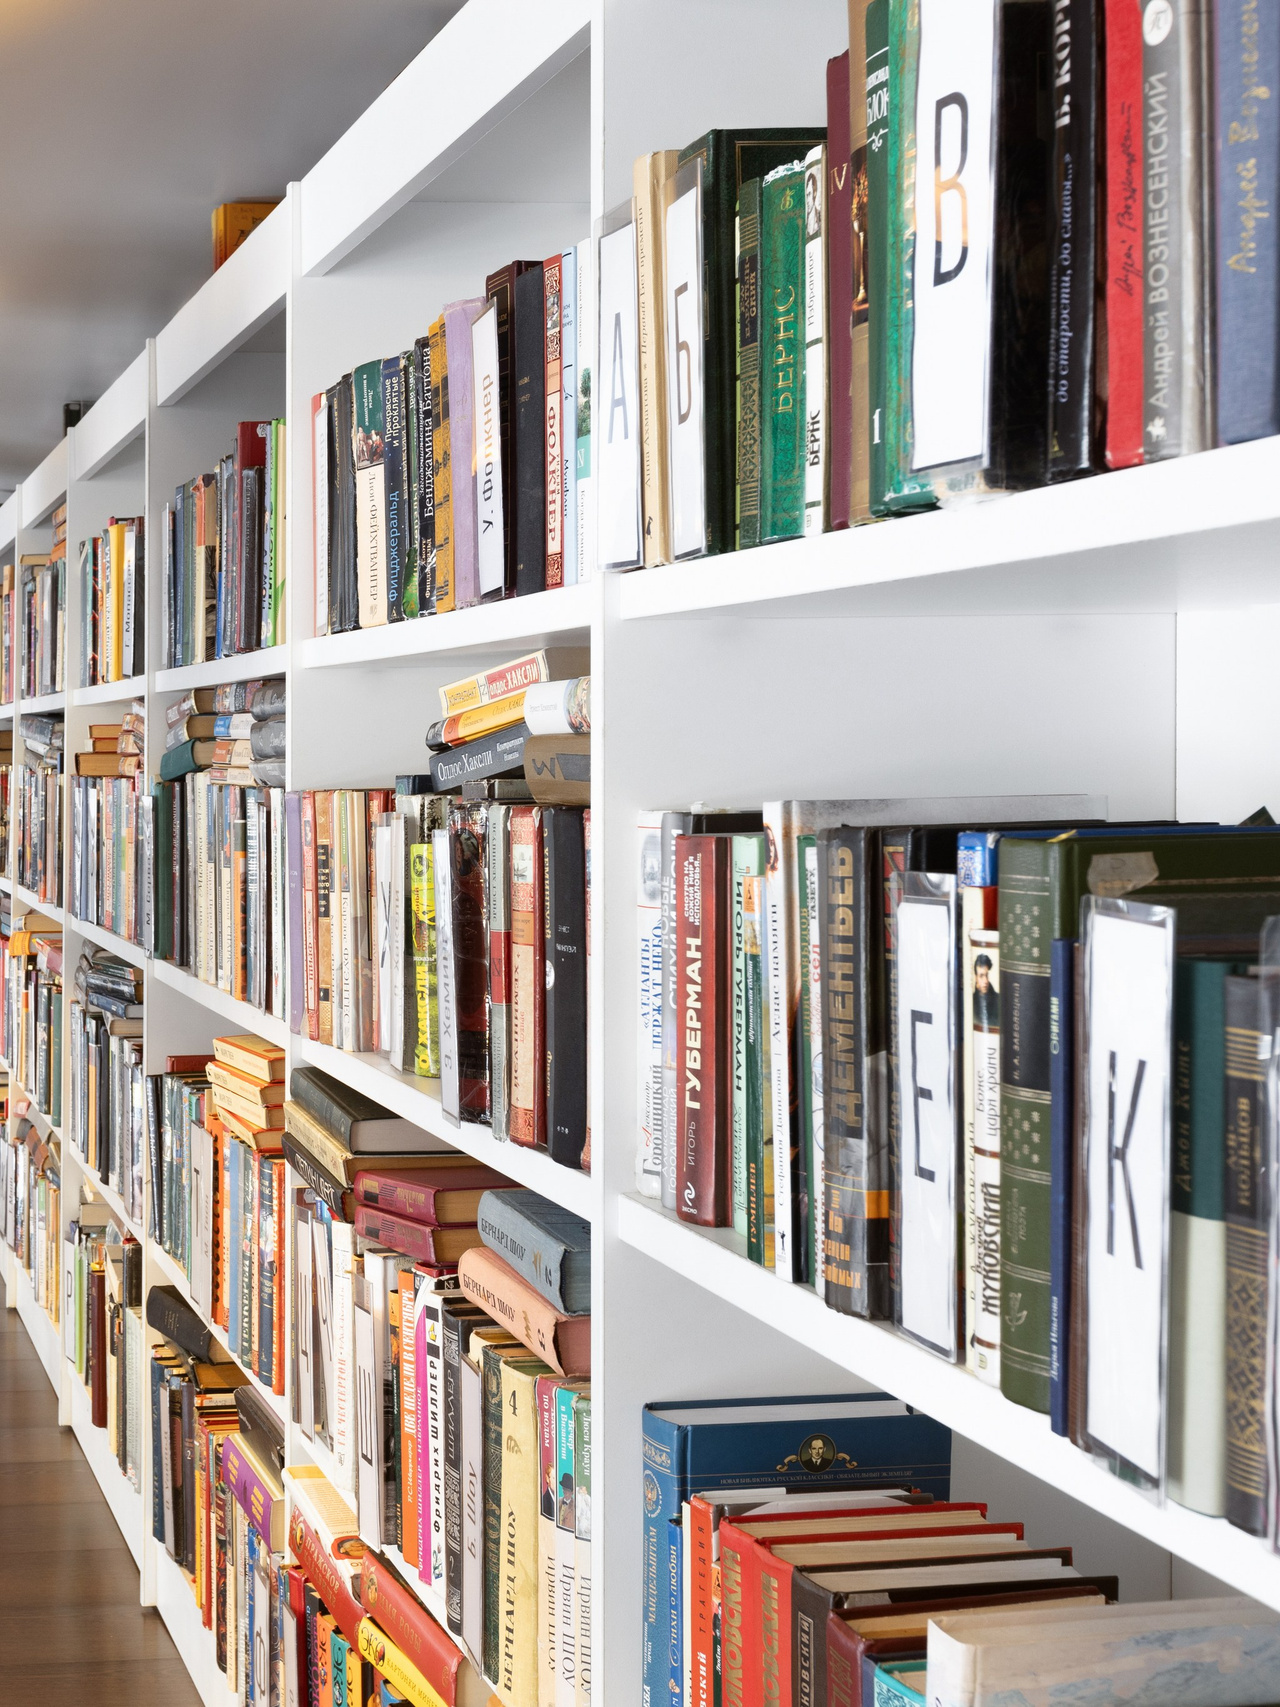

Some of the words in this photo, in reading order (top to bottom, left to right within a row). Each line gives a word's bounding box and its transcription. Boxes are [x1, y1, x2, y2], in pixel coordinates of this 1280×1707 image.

[1055, 95, 1072, 129] Б.
[933, 92, 968, 287] В
[1144, 71, 1169, 302] ВОЗНЕСЕНСКИЙ
[1226, 158, 1270, 274] Андрей
[806, 250, 816, 327] Избранное
[1058, 243, 1071, 265] до
[674, 281, 692, 425] Б
[772, 285, 796, 414] БЕРНС
[1058, 269, 1073, 375] старости,
[422, 346, 432, 411] Баттона
[607, 312, 629, 444] А
[1056, 379, 1069, 403] до
[1147, 311, 1174, 409] Андрей
[384, 378, 393, 442] Прекрасные
[391, 376, 400, 437] проклятые
[482, 373, 494, 502] Фолкнер
[641, 377, 651, 447] Ахматова
[809, 409, 821, 466] БЕРНС
[874, 408, 882, 443] 1
[423, 417, 434, 518] Бенджамина
[547, 406, 558, 542] ФОЛКНЕР
[643, 448, 651, 489] Анна
[369, 504, 379, 601] ФЕЙХТВАНГЕР
[388, 491, 401, 602] Фицджеральд
[482, 510, 494, 535] У.
[505, 663, 539, 690] ХАКСЛИ
[437, 758, 463, 781] Олдос
[461, 750, 493, 773] Хаксли
[496, 736, 524, 753] Контрапункт
[661, 876, 669, 950] НОВЫЕ
[735, 880, 743, 960] ИГОРЬ
[770, 902, 780, 978] памяти
[342, 947, 351, 1024] ФУЭНТЕС
[640, 937, 651, 1029] «АТЛАНТЫ
[811, 943, 820, 983] сел
[827, 846, 862, 1128] ДЕМЕНТЬЕВ
[416, 964, 429, 1046] ХАКСЛИ
[512, 964, 521, 1089] ХЕМИНГУЭЙ
[651, 978, 662, 1051] ДЕРЖАТ
[685, 936, 702, 1110] ГУБЕРМАН
[735, 967, 743, 1092] ГУБЕРМАН
[771, 984, 781, 1043] Атлас
[1011, 982, 1021, 1052] ЗАБОЛОЦКИЙ
[1050, 996, 1060, 1055] ОРИГАМИ
[774, 1067, 784, 1135] Данилова
[911, 1009, 936, 1183] Е
[1174, 1039, 1191, 1110] Китс
[641, 1081, 652, 1148] Александр
[661, 1086, 670, 1179] Александр
[668, 1088, 678, 1194] Городницкий
[687, 1121, 696, 1167] ИГОРЬ
[774, 1137, 786, 1207] Стефания
[1108, 1050, 1148, 1270] К
[1174, 1122, 1193, 1192] Джон
[1237, 1096, 1253, 1207] КОЛЬЦОВ
[749, 1162, 758, 1244] ГУМИЛЕВ
[480, 1217, 509, 1250] БЕРНАРД
[508, 1240, 527, 1261] ШОУ
[981, 1182, 1001, 1316] ЖУКОВСКИЙ
[401, 1289, 414, 1352] СЕНТЯБРЕ
[462, 1273, 498, 1311] БЕРНАРД
[498, 1302, 517, 1323] ШОУ
[336, 1358, 346, 1425] ЧЕСТЕРТОН
[358, 1365, 373, 1467] Ш
[402, 1362, 416, 1411] НЕДЕЛИ
[429, 1360, 439, 1441] ШИЛЛЕР
[447, 1369, 455, 1461] ШИЛЛЕР
[509, 1390, 518, 1417] 4
[542, 1394, 549, 1409] по
[403, 1411, 417, 1437] ДВЕ
[582, 1412, 591, 1441] Люси
[432, 1446, 442, 1534] Фридрих
[467, 1460, 478, 1526] Шоу
[582, 1443, 591, 1476] Краун
[802, 1474, 834, 1482] КЛАССИКИ
[304, 1535, 341, 1594] ПРАЖСКОЕ
[467, 1537, 476, 1560] Б.
[506, 1502, 516, 1568] ШОУ
[545, 1555, 556, 1617] Ирвин
[560, 1562, 575, 1626] Ирвин
[577, 1573, 591, 1639] Ирвин
[648, 1526, 657, 1625] МАНДЕЛЬШТАМ
[697, 1526, 707, 1634] ТРАГЕДИЯ
[360, 1624, 386, 1668] ЭКО
[378, 1589, 399, 1619] ИМЯ
[399, 1611, 423, 1655] РОЗЫ
[503, 1573, 516, 1694] БЕРНАРД
[562, 1631, 576, 1688] ШОУ
[580, 1642, 591, 1697] ШОУ
